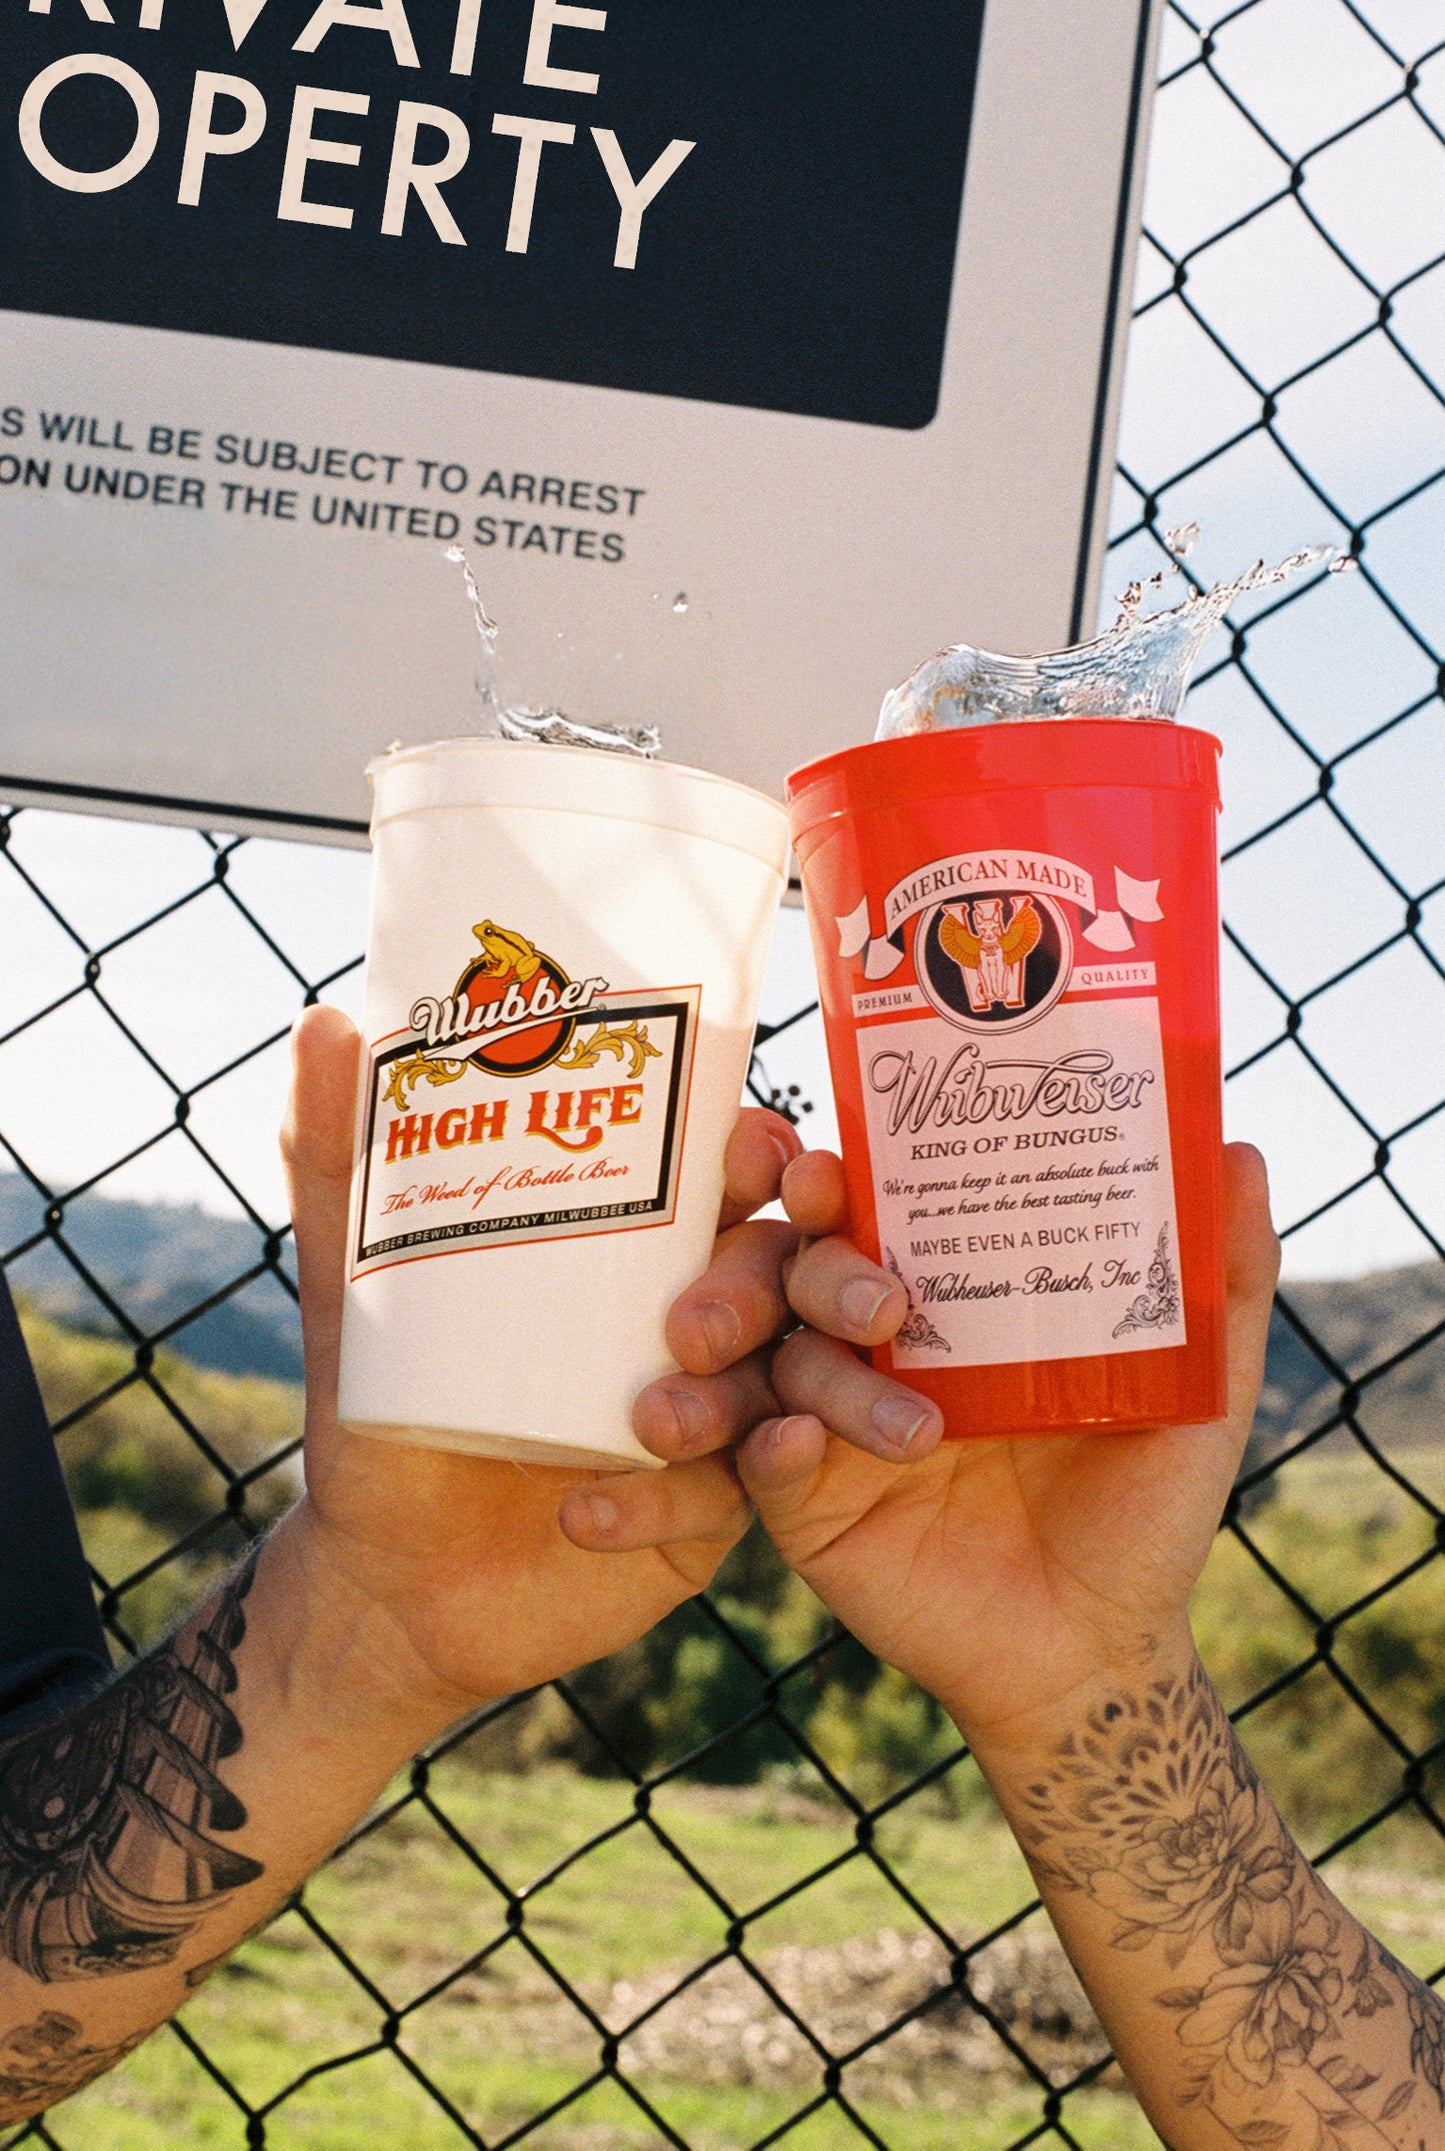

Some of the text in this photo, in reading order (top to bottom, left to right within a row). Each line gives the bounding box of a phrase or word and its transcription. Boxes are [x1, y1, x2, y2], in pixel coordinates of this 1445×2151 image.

[18, 53, 697, 270] OPERTY
[39, 411, 133, 451] WILL
[148, 425, 202, 459] BE
[215, 433, 403, 485] SUBJECT
[417, 460, 468, 493] TO
[479, 469, 645, 516] ARREST
[64, 462, 205, 509] UNDER
[220, 482, 297, 520] THE
[312, 494, 460, 541] UNITED
[473, 516, 624, 563] STATES
[890, 859, 1088, 921] AMERICAN MADE
[857, 992, 913, 1011] PREMIUM
[1080, 967, 1150, 986] QUALITY
[409, 976, 610, 1047] Wubber
[385, 1083, 644, 1164] HIGH LIFE
[910, 1140, 967, 1161] KING
[973, 1135, 1008, 1155] OF
[380, 1156, 631, 1215] The Weed of Bottle Beer
[882, 1154, 1160, 1200] We're gonna keep it an absolute buck with
[956, 1198, 992, 1215] have
[993, 1194, 1018, 1211] the
[1021, 1192, 1050, 1209] best
[1053, 1188, 1103, 1209] tasting
[1105, 1183, 1138, 1201] beer.
[365, 1200, 654, 1257] WUBBER BREWING COMPANY MILWUBBEE USA
[910, 1221, 1141, 1257] MAYBE EVEN A BUCK FIFTY
[1100, 1258, 1142, 1289] Inc
